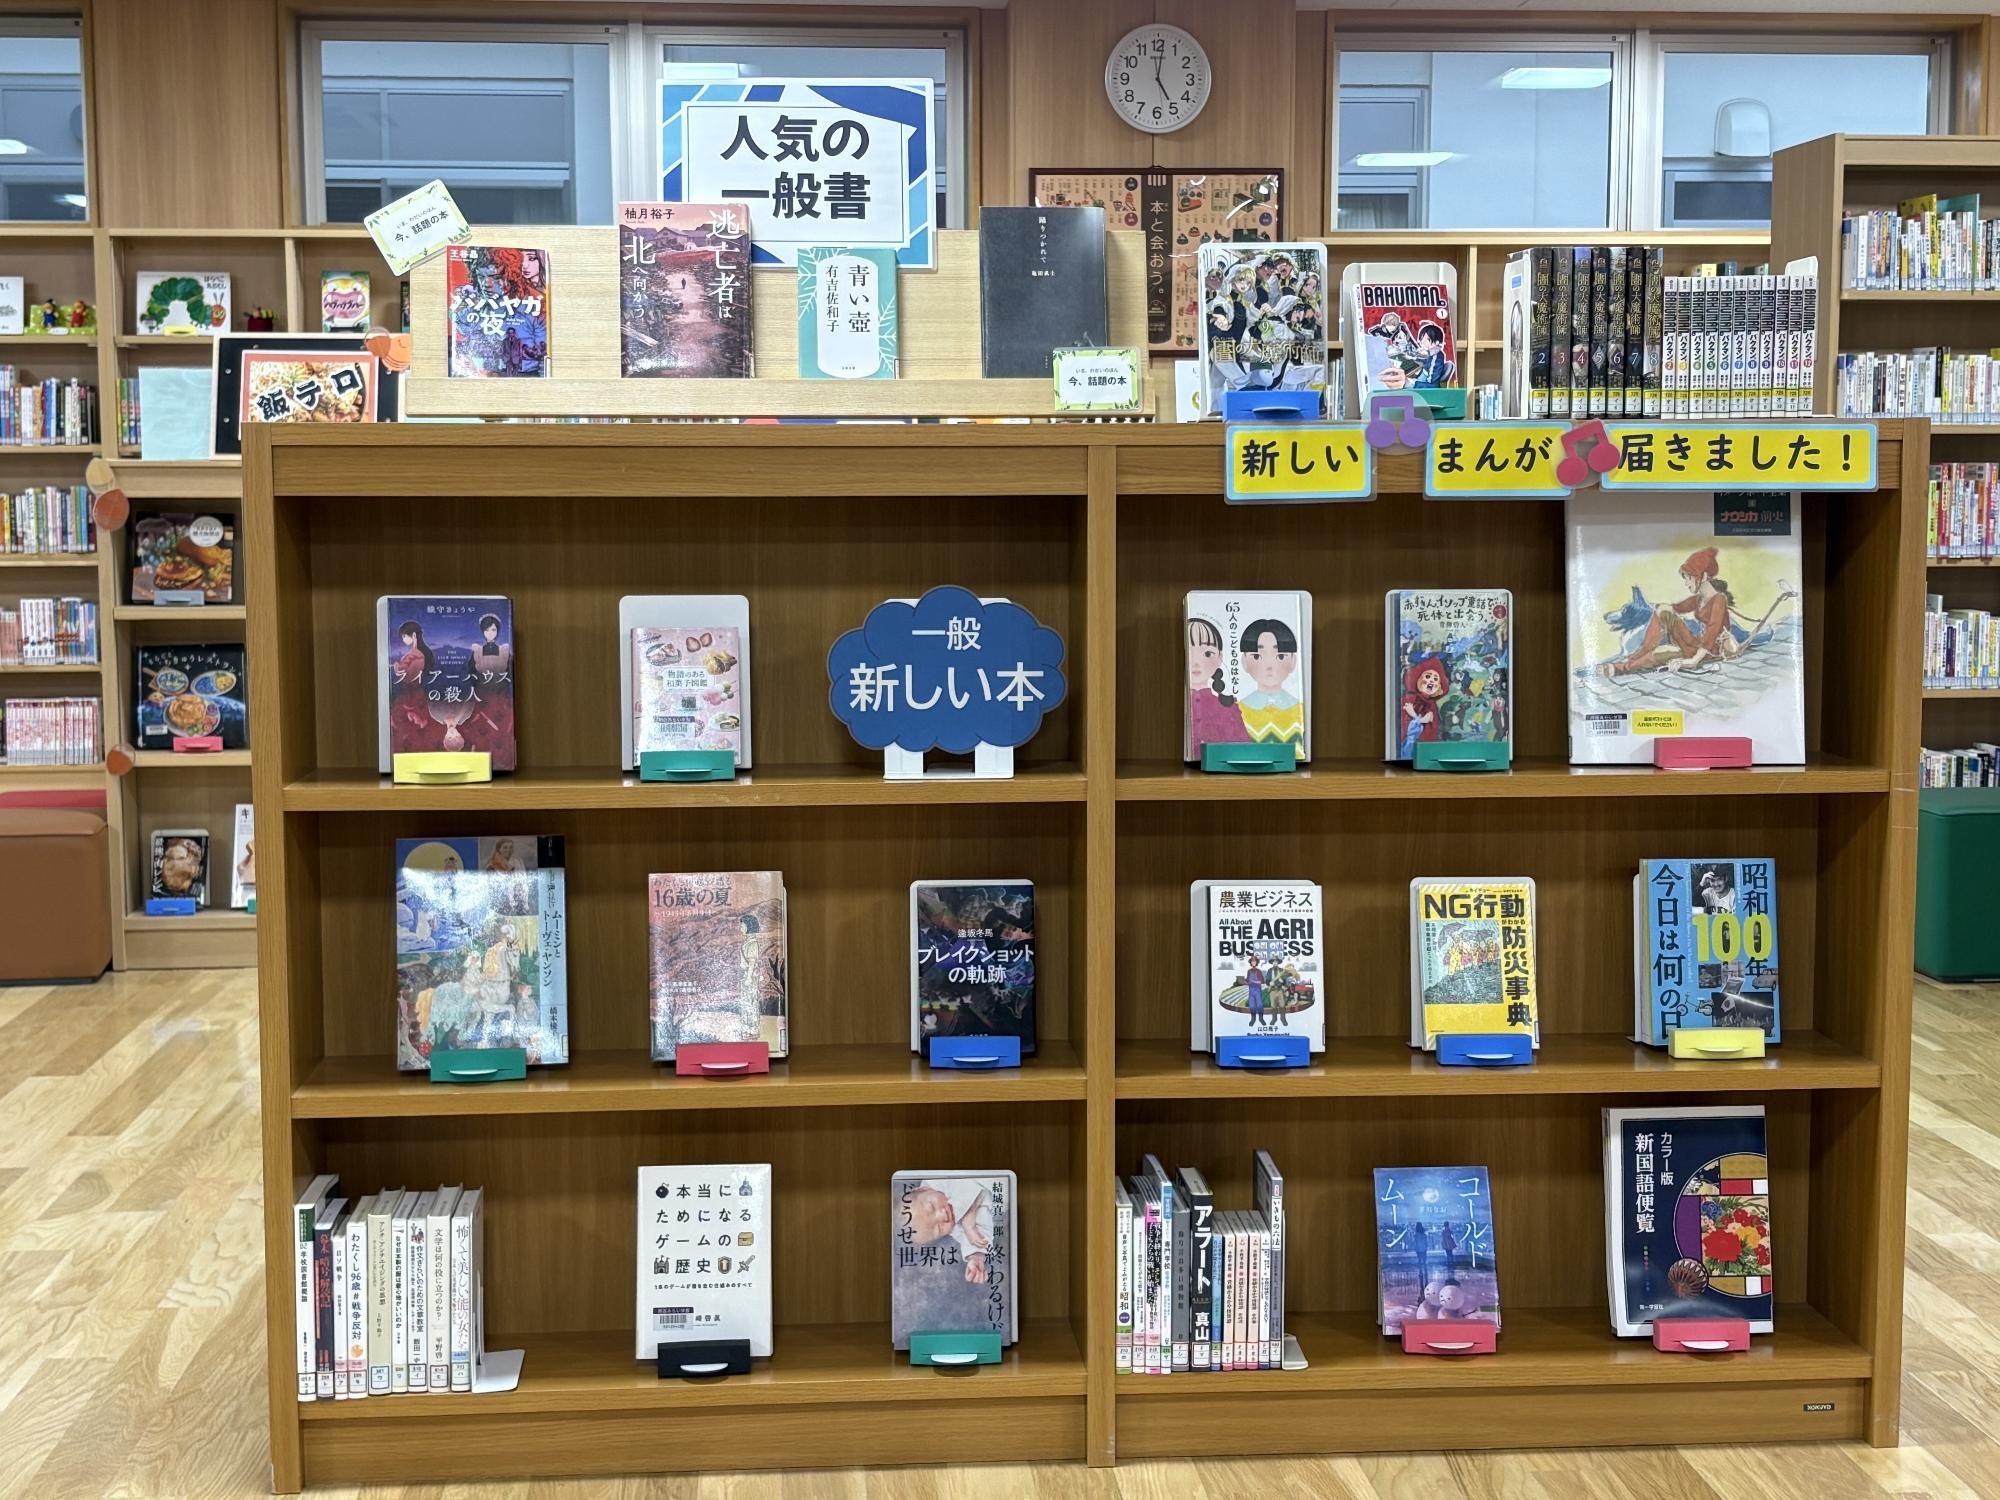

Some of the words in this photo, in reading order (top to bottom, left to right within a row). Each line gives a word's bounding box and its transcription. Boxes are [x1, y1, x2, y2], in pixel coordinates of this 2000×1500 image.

[1136, 43, 1147, 56] 11
[1152, 39, 1165, 52] 12
[1172, 43, 1177, 56] 1
[1124, 56, 1138, 68] 10
[1182, 56, 1191, 69] 2
[1120, 73, 1130, 85] 9
[1186, 73, 1195, 86] 3
[1125, 90, 1134, 102] 8
[1181, 90, 1191, 103] 4
[1136, 102, 1145, 114] 7
[1153, 107, 1162, 119] 6
[1169, 103, 1178, 115] 5
[720, 114, 870, 162] 人気の
[721, 171, 871, 220] 一般書
[625, 208, 675, 220] 柚月裕子
[395, 209, 449, 243] 今、話題の本
[1150, 200, 1166, 294] 本と会おう。
[706, 209, 741, 319] 逃亡者は
[623, 236, 656, 320] 北へ向かう
[449, 292, 544, 317] ババヤガ
[826, 265, 839, 332] 有吉佐和子
[848, 265, 871, 333] 青い壺
[466, 311, 506, 336] の夜
[1538, 352, 1545, 364] 2
[1558, 352, 1565, 365] 3
[1577, 352, 1585, 363] 4
[1595, 352, 1602, 363] 5
[1613, 352, 1621, 363] 6
[1631, 352, 1639, 365] 7
[1650, 352, 1658, 364] 8
[1068, 376, 1127, 387] 今、話題の本
[257, 369, 360, 420] 飯テロ
[1241, 438, 1358, 477] 新しい
[1437, 436, 1554, 474] まんが
[1618, 433, 1853, 473] 届きました！
[1721, 511, 1758, 522] ナウシカ
[912, 616, 981, 650] 一般
[1225, 602, 1240, 694] 65人のこどものはなし
[394, 670, 512, 685] ライアーハウス
[850, 662, 1045, 712] 新しい本
[428, 686, 482, 703] の殺人
[654, 887, 731, 907] 16歳の夏
[1219, 890, 1312, 908] 農業ビジネス
[1425, 893, 1525, 918] NG行動
[957, 929, 993, 938] 逢坂冬馬
[1219, 926, 1253, 939] THE
[1257, 918, 1314, 940] AGRI
[918, 944, 1034, 964] ブレイクショット
[1652, 864, 1685, 1039] 今日は何の日
[948, 965, 1006, 984] の軌跡
[1502, 926, 1532, 1027] 防災事典
[1660, 1131, 1674, 1186] カラー版
[676, 1184, 732, 1199] 本当に
[1634, 1132, 1655, 1234] 新国語便覧
[656, 1208, 751, 1224] ためになる
[897, 1183, 917, 1245] どうせ
[992, 1182, 1004, 1237] 結城真一郎
[1381, 1178, 1407, 1248] ムーン
[1272, 1201, 1281, 1247] いきもの六法
[1454, 1177, 1489, 1268] コールド
[655, 1234, 731, 1250] ゲームの
[1193, 1205, 1213, 1294] アラート
[675, 1258, 711, 1275] 歴史
[896, 1247, 958, 1268] 世界は
[1195, 1312, 1209, 1341] 真山
